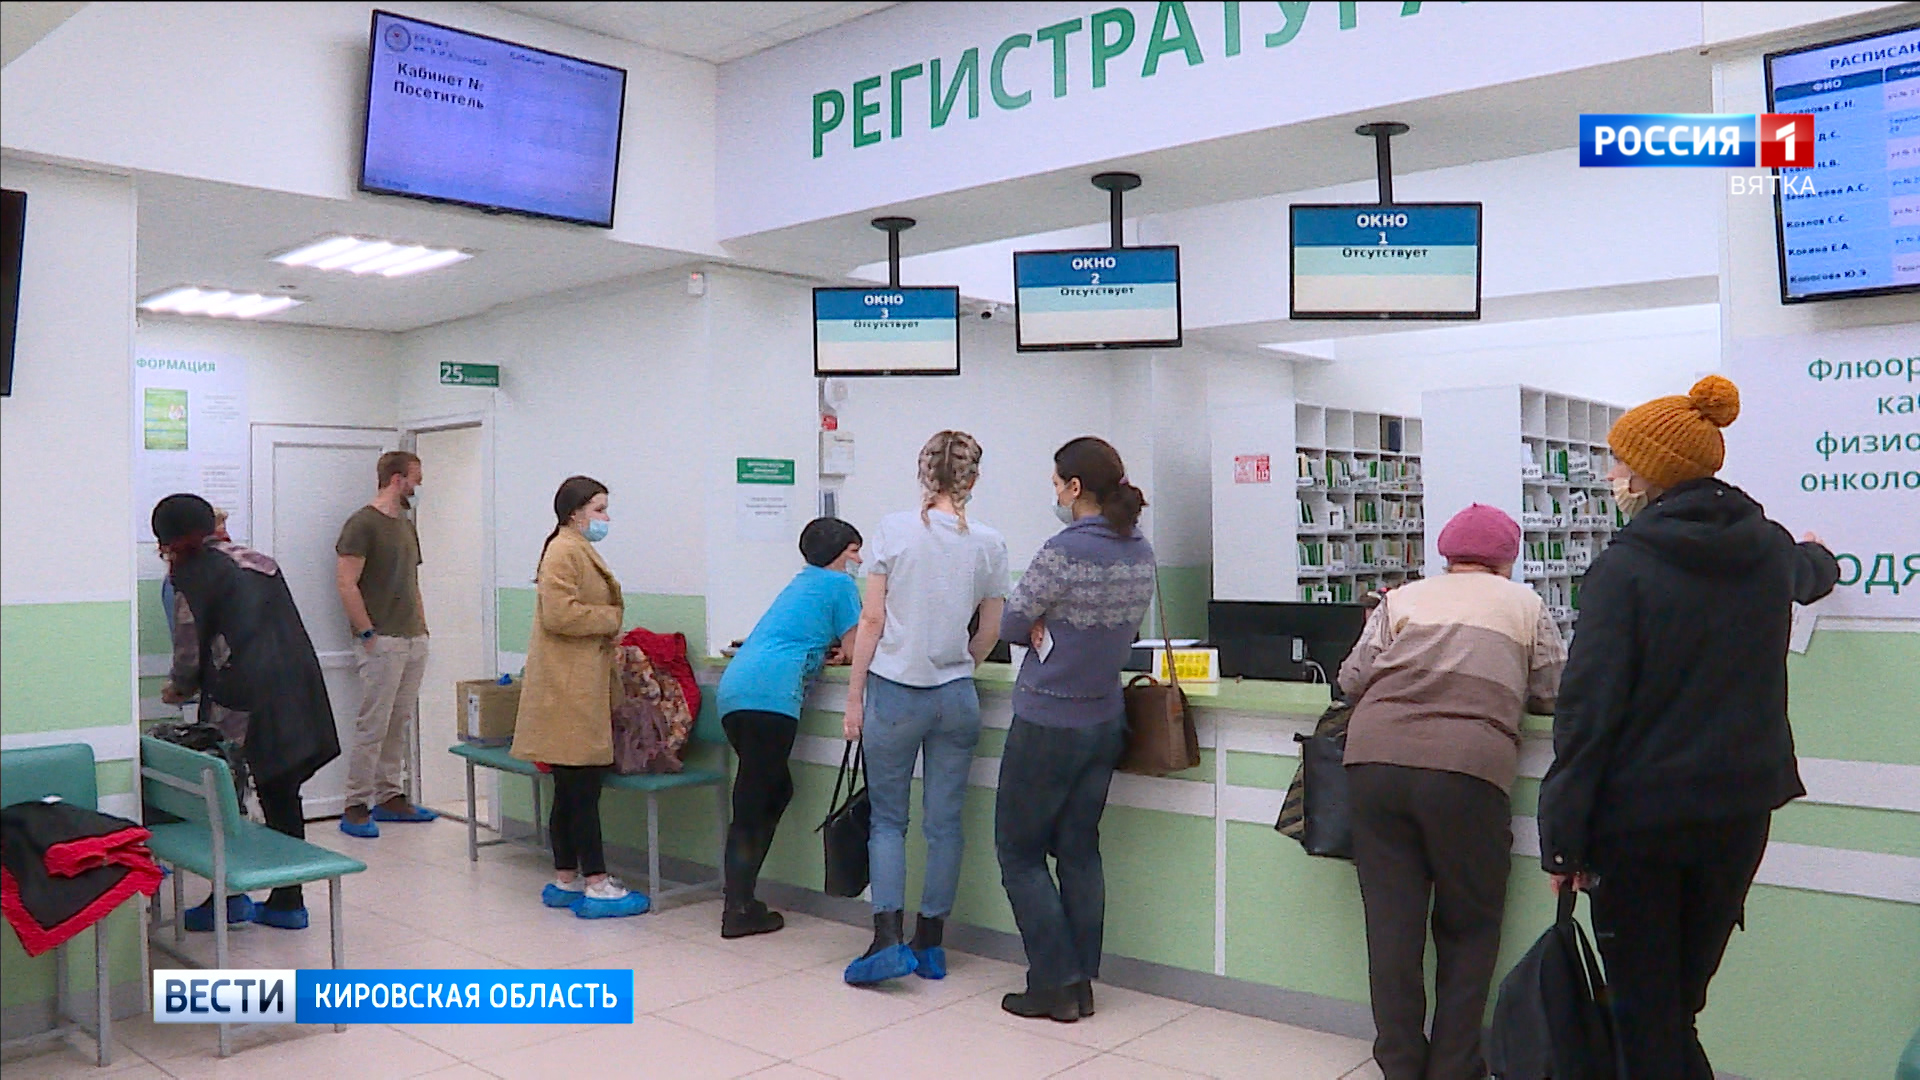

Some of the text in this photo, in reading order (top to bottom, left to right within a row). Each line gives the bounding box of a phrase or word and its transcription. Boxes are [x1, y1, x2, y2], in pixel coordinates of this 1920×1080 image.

[397, 62, 464, 87] Кабинет
[812, 0, 1473, 159] РЕГИСТРАТУ
[1812, 79, 1842, 92] ФИО
[394, 80, 485, 110] Посетитель
[1357, 213, 1408, 228] ОКНО
[1378, 231, 1389, 245] 1
[1342, 247, 1428, 260] Отсутствует
[1071, 257, 1116, 271] ОКНО
[1090, 273, 1100, 285] 2
[1060, 287, 1135, 298] Отсутствует
[863, 294, 904, 306] ОКНО
[880, 307, 889, 319] 3
[441, 364, 464, 383] 25
[1877, 391, 1920, 415] ка
[1816, 431, 1920, 462] физио
[1801, 471, 1920, 492] онколо
